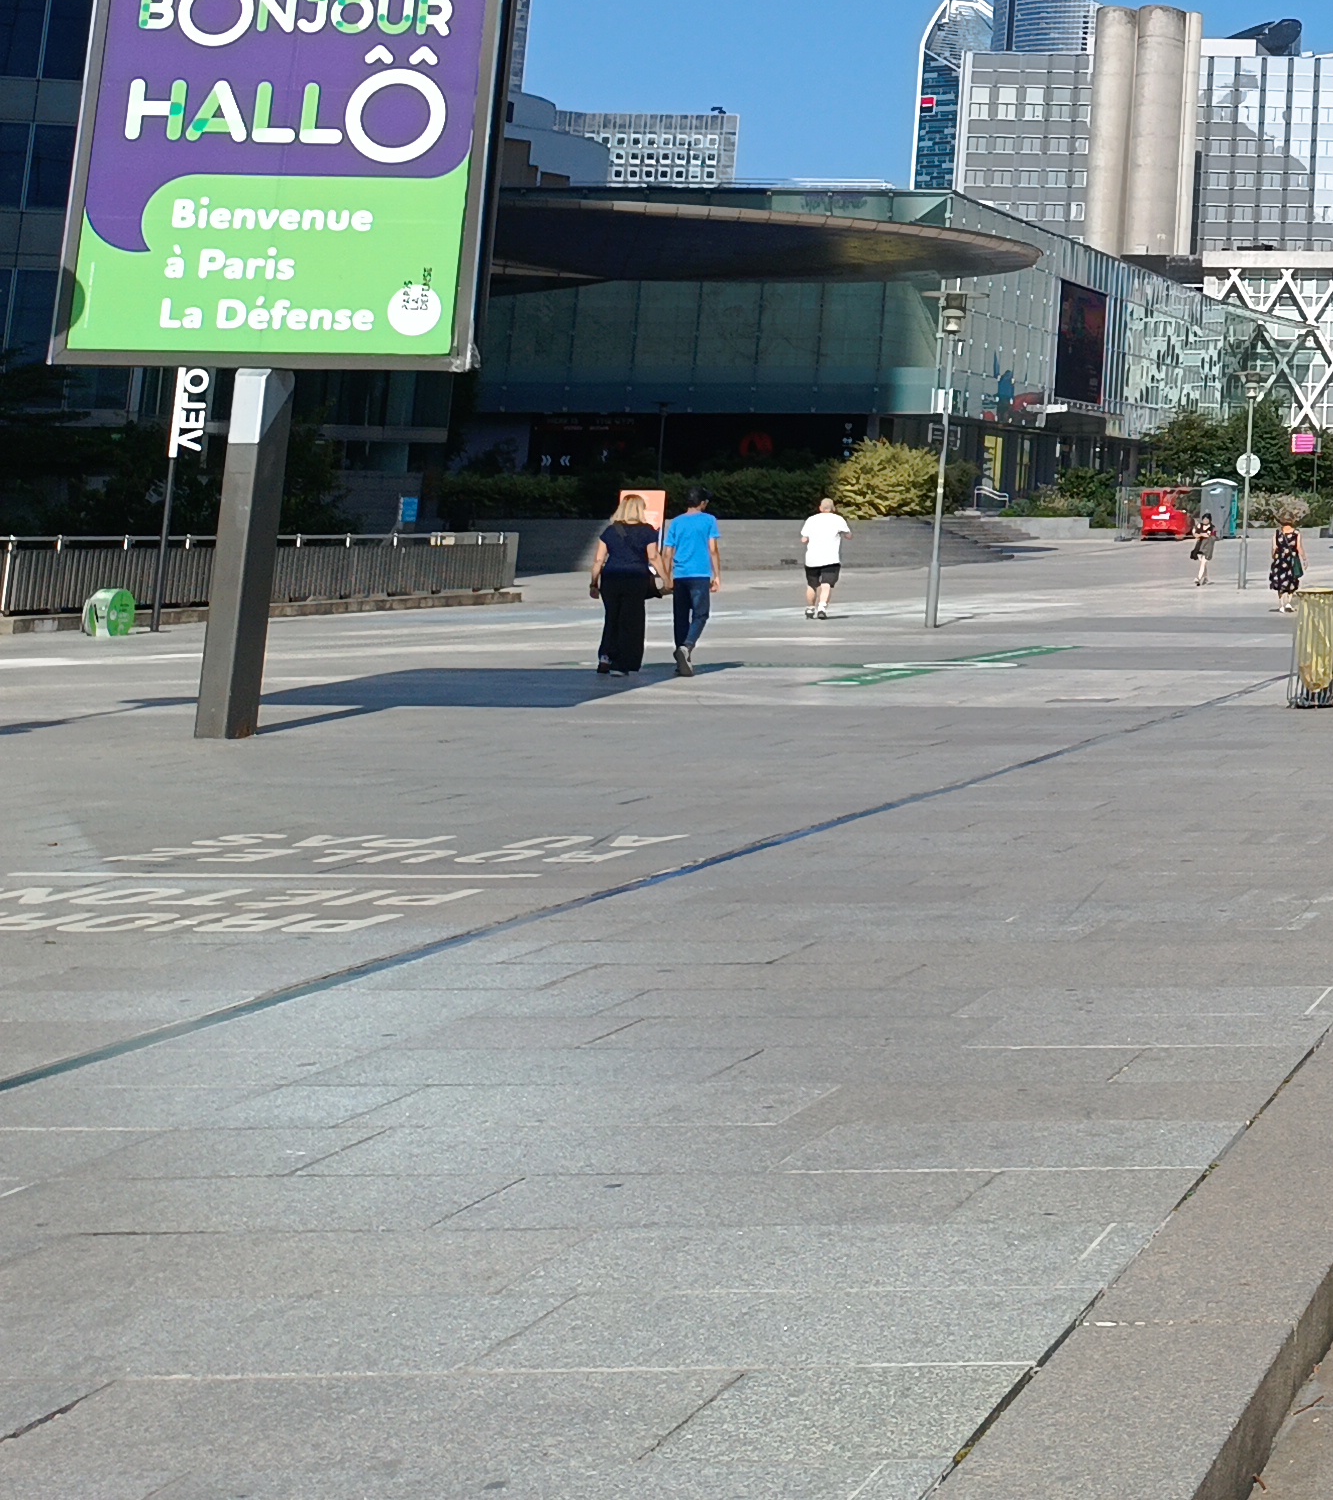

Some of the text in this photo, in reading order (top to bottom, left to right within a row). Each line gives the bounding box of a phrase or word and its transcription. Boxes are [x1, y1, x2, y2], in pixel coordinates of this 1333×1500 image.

[171, 196, 374, 233] Bienvenue
[163, 244, 296, 281] à Paris
[159, 294, 375, 332] La Défense
[191, 833, 690, 849] AU PAS
[102, 848, 638, 863] ROULEZ
[0, 887, 484, 909] PIÉTON
[0, 912, 404, 932] PRIOR
